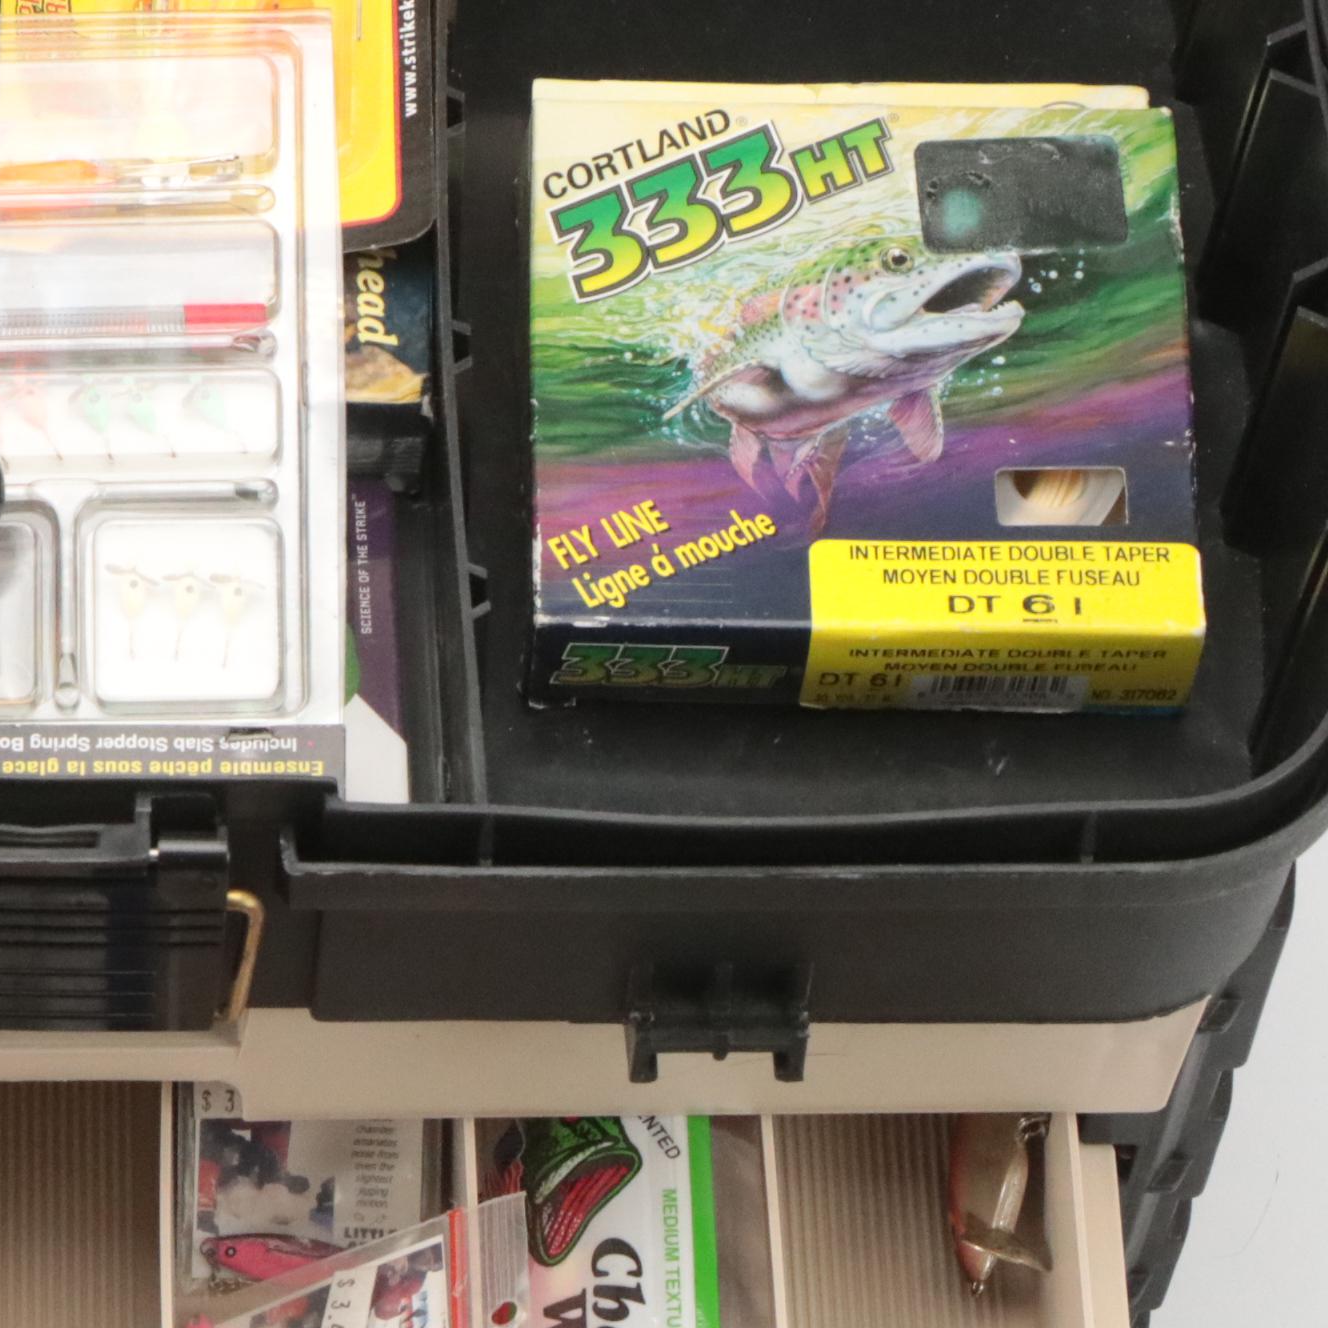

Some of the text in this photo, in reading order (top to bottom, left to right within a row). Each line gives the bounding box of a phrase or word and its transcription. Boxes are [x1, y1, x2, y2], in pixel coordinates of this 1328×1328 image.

[543, 109, 731, 200] CORTLAND
[547, 498, 671, 571] FLY LINE
[572, 562, 651, 609] Ligne
[673, 508, 777, 570] mouche
[849, 545, 1171, 563] INTERMEDIATE DOUBLE TAPER
[354, 500, 372, 635] SCIENCE OF THE STRIKE
[882, 569, 1141, 587] MOYEN DOUBLE FUSEAU
[948, 595, 1001, 615] DT
[1021, 593, 1056, 616] 6
[849, 648, 1167, 660] INTERMEDIATE DOUBLE TAPER
[883, 661, 1137, 673] MOYEN DOUBLE FUSEAU
[818, 672, 856, 687] DT
[30, 735, 90, 753] Spring
[95, 735, 168, 753] Stopper
[173, 736, 215, 752] Slab
[1, 759, 324, 776] Ensemble pêche sous la glace
[637, 1115, 681, 1160] NTED
[662, 1188, 680, 1262] MEDIUM
